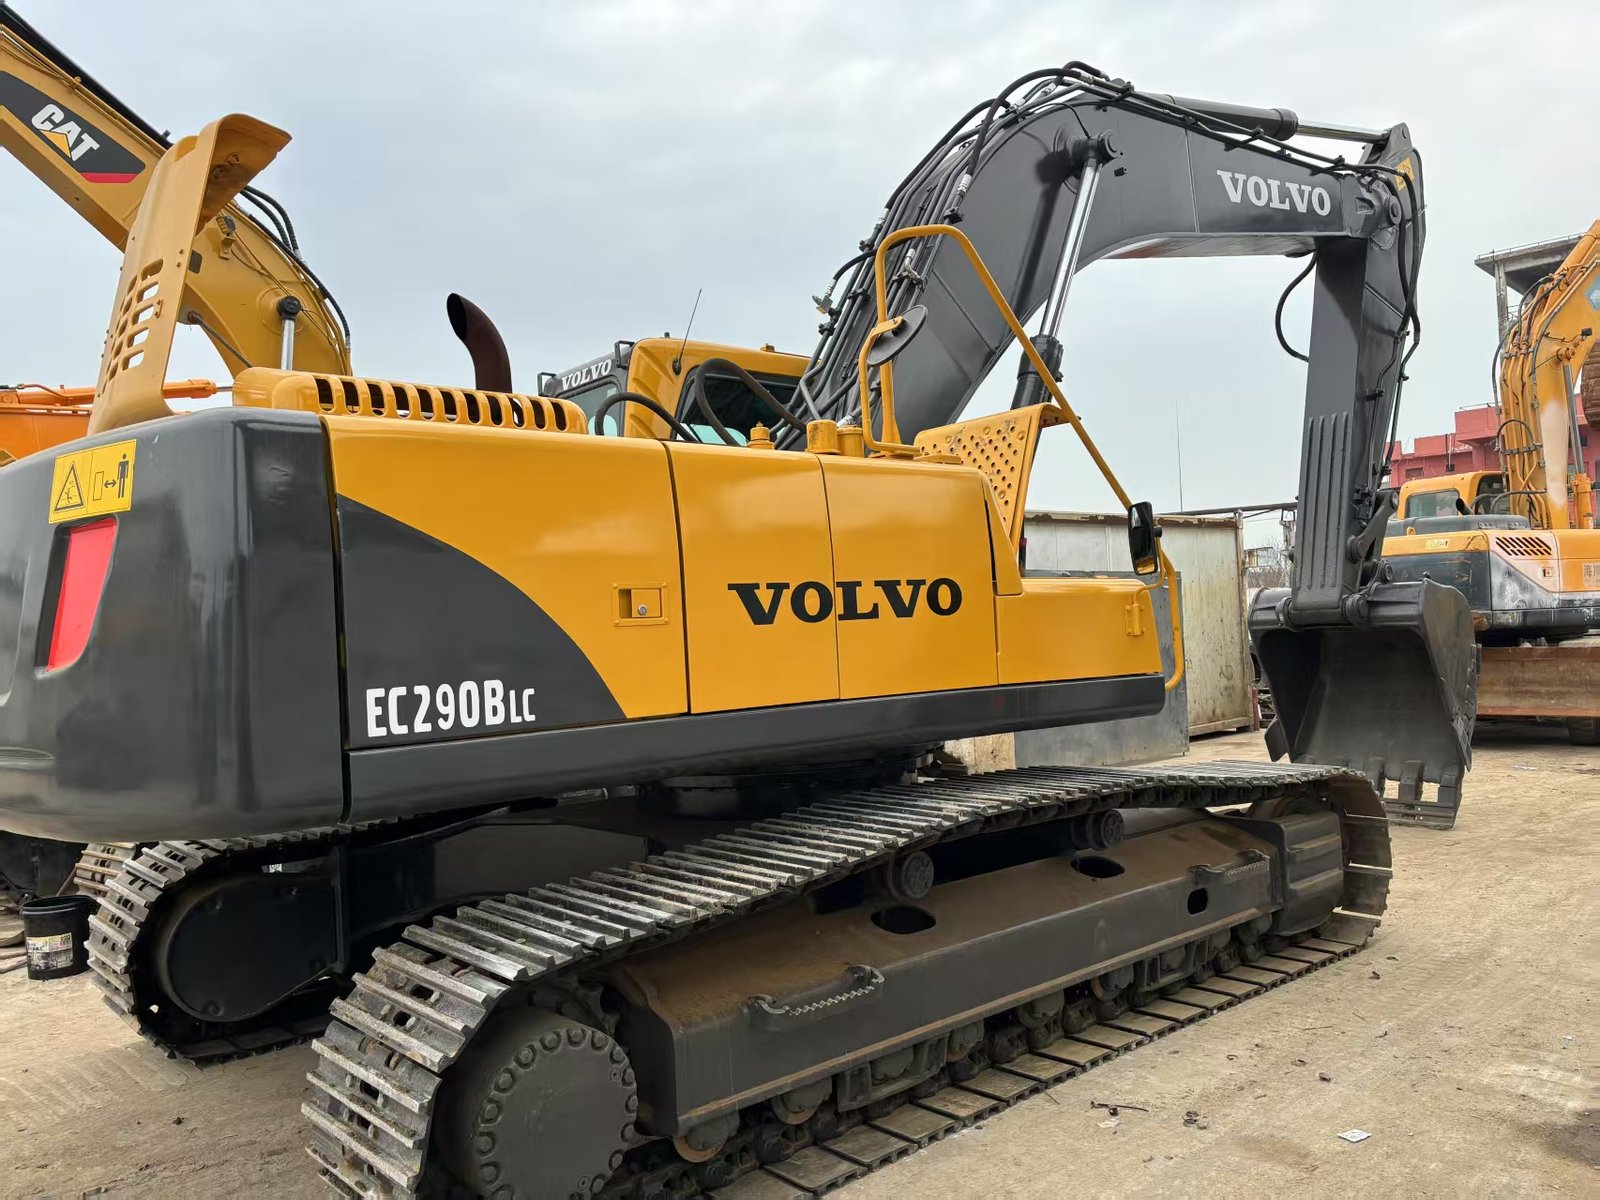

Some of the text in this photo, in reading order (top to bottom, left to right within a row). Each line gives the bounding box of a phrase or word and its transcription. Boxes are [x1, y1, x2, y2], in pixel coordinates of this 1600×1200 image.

[31, 103, 100, 162] CAT
[1216, 169, 1331, 216] VOLVO
[561, 359, 612, 391] VOLVO
[727, 577, 963, 626] VOLVO
